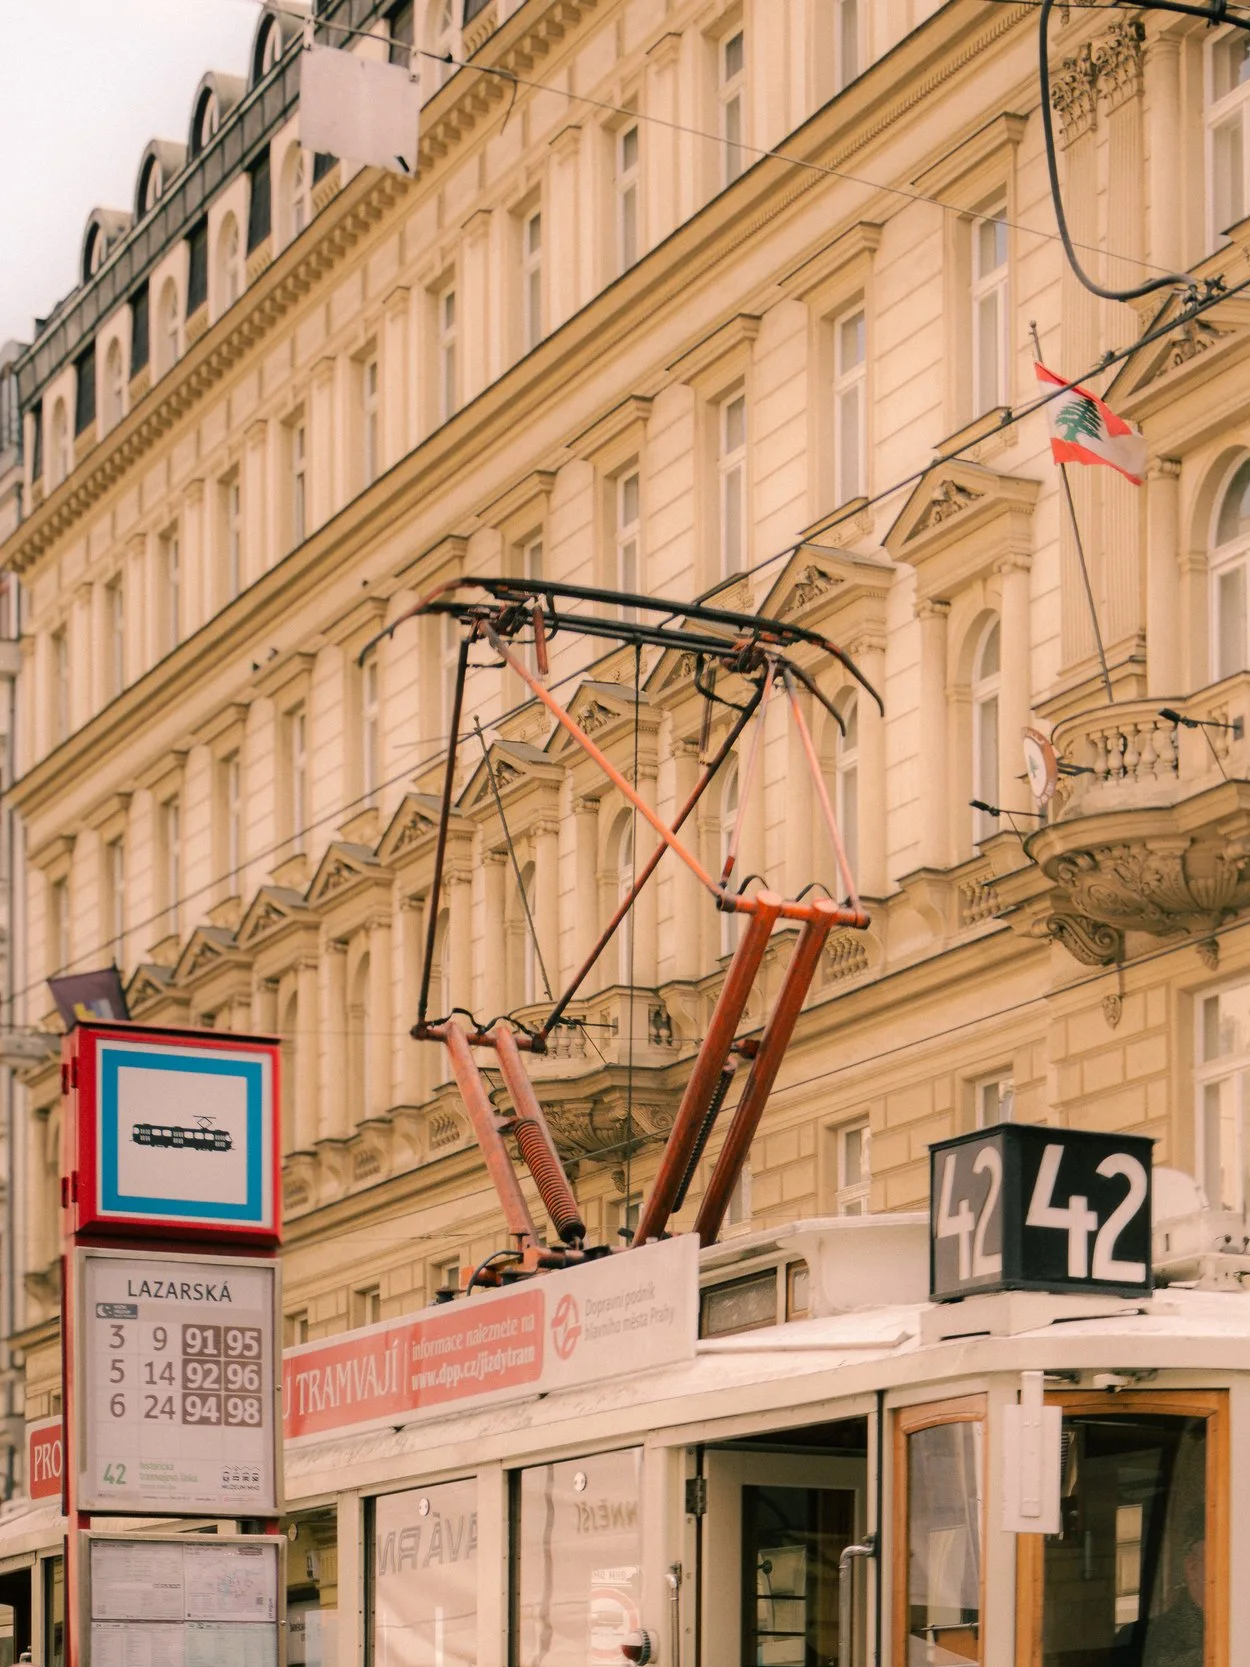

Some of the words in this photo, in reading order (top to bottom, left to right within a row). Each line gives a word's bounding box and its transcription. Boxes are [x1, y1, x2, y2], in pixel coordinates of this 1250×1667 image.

[936, 1146, 1002, 1281] 42
[1025, 1143, 1148, 1283] 42
[127, 1279, 232, 1302] LAZARSKÁ
[108, 1324, 125, 1349] 3
[152, 1326, 168, 1351] 9
[185, 1327, 217, 1354] 91
[226, 1329, 259, 1356] 95
[412, 1333, 462, 1361] informace
[466, 1316, 518, 1347] naleznete
[521, 1314, 535, 1332] na
[109, 1358, 125, 1383] 5
[144, 1360, 175, 1386] 14
[185, 1361, 220, 1389] 92
[226, 1363, 260, 1390] 96
[296, 1338, 399, 1416] TRAMVAJÍ
[110, 1392, 126, 1418] 6
[143, 1394, 176, 1420] 24
[184, 1395, 220, 1422] 94
[226, 1397, 260, 1424] 98
[103, 1463, 127, 1485] 42
